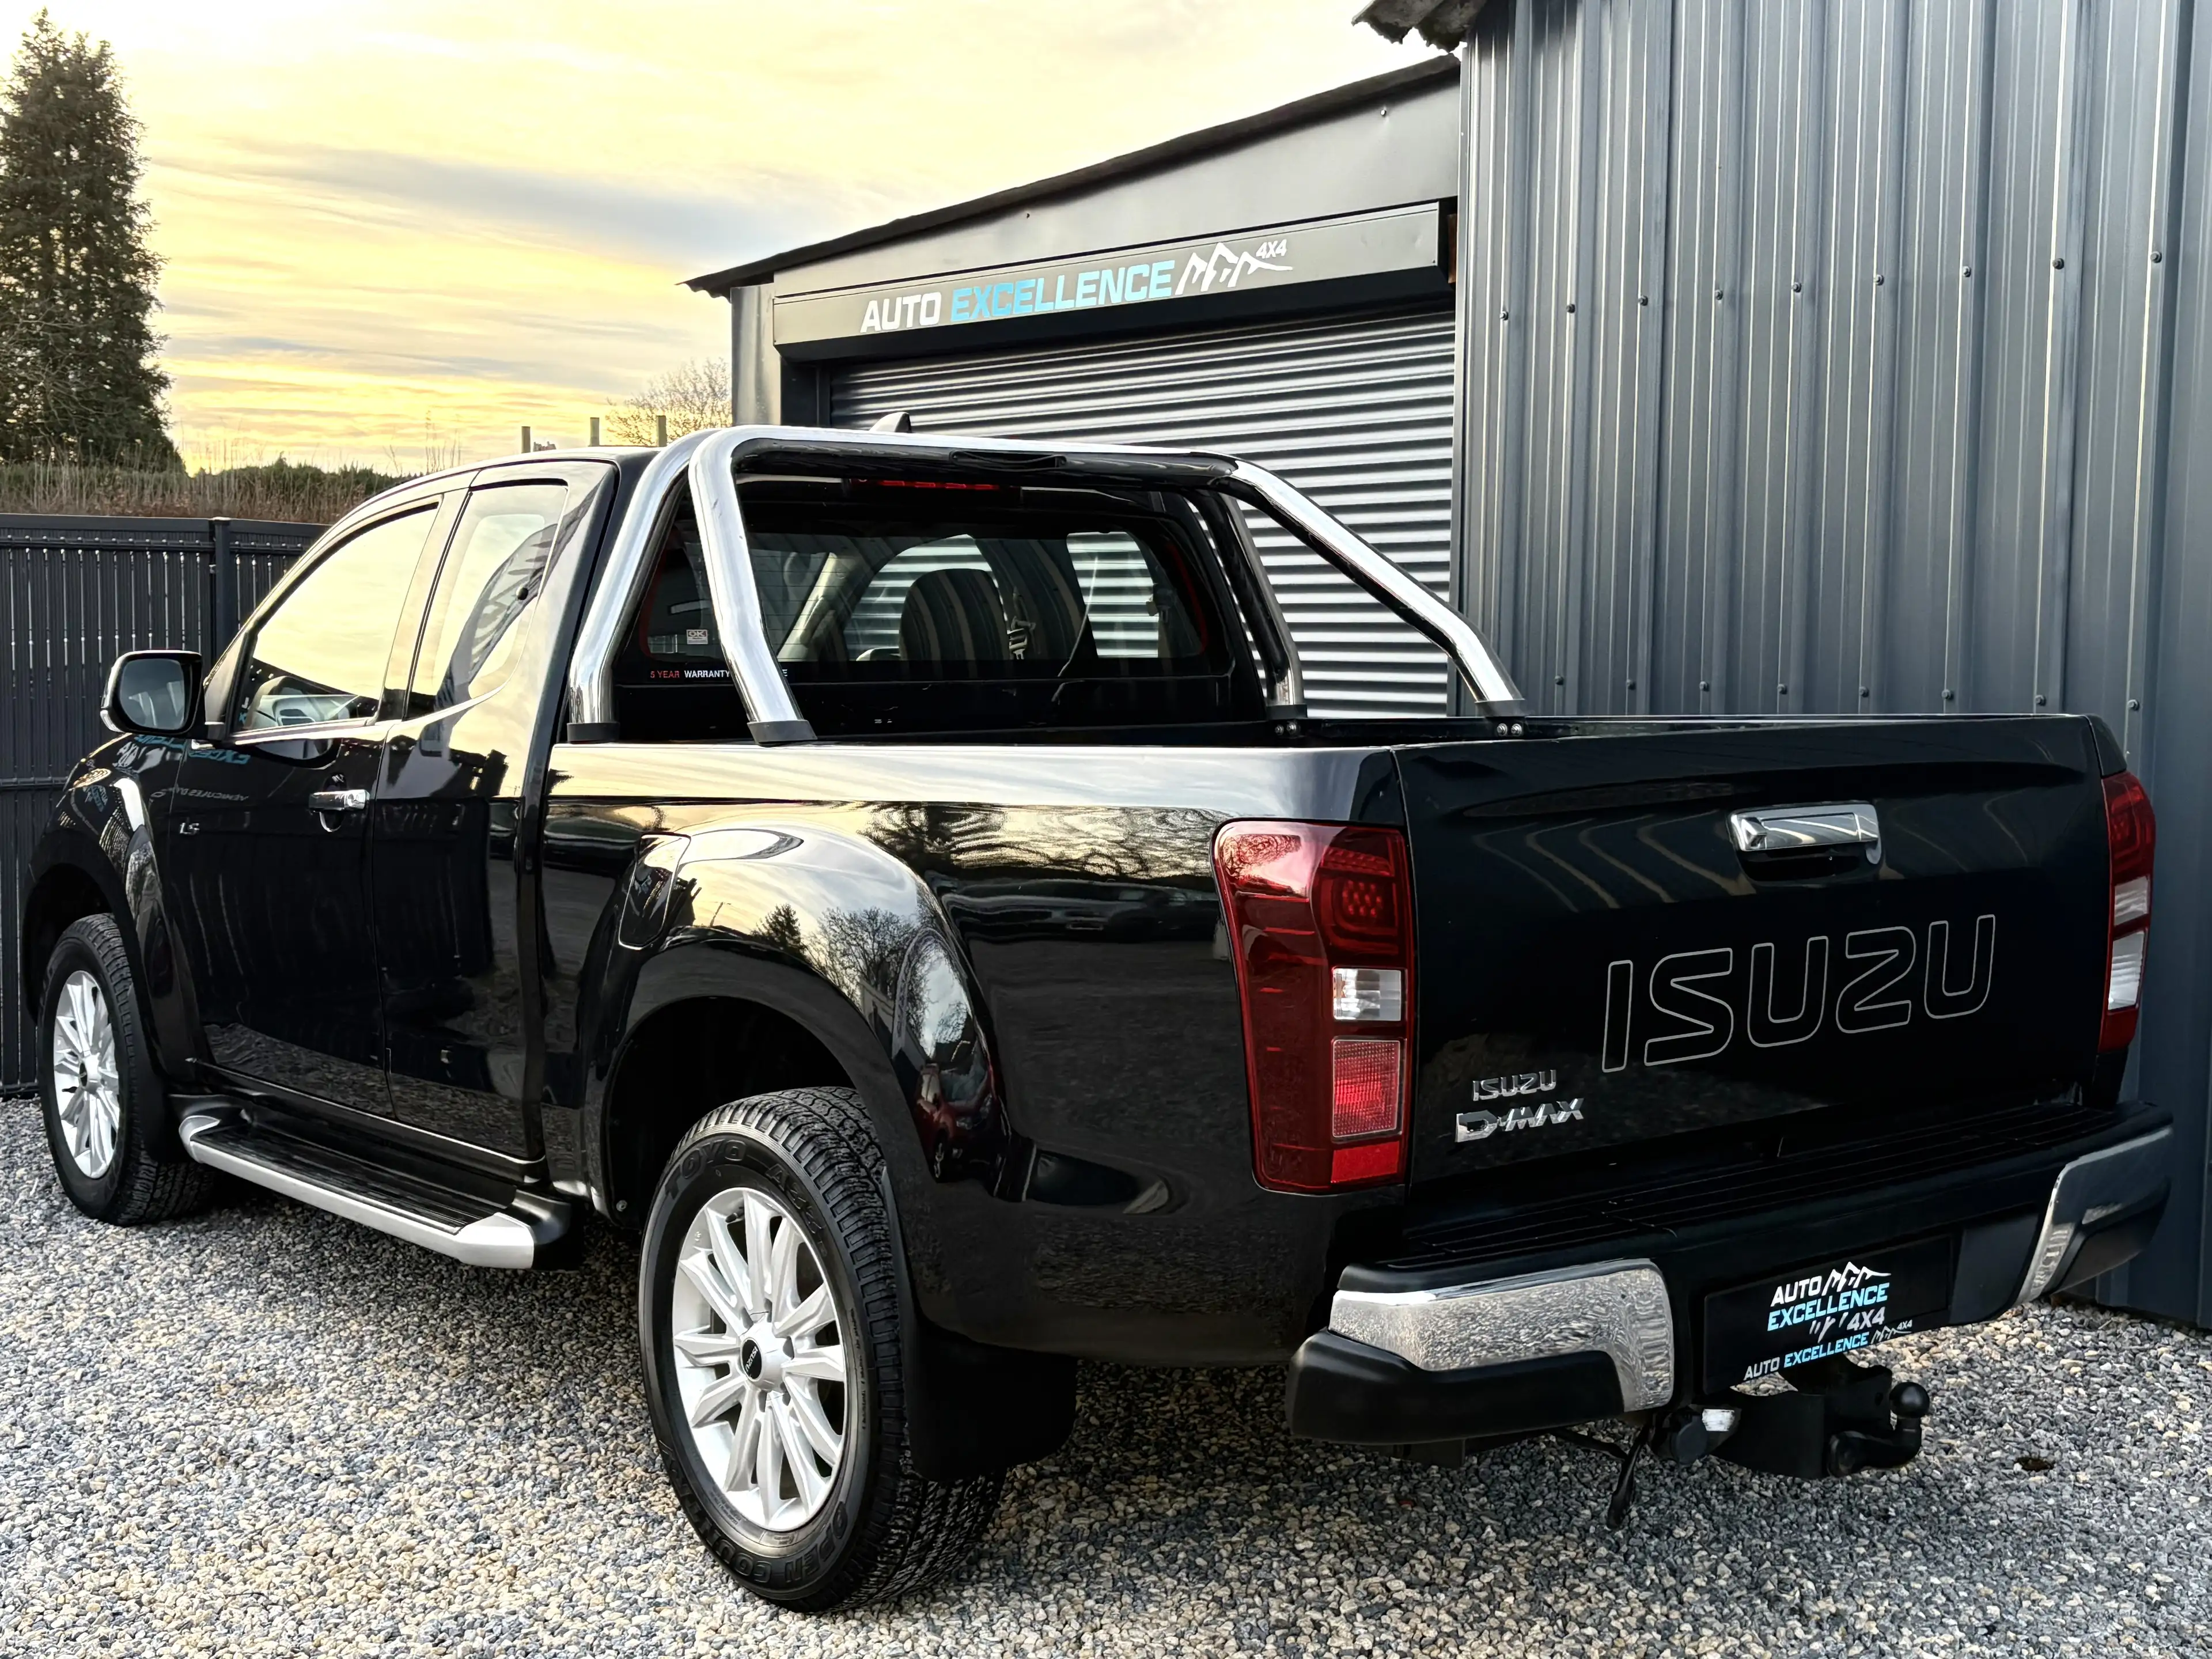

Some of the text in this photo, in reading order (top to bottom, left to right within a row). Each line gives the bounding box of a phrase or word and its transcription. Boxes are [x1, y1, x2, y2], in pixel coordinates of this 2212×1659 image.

[859, 238, 1287, 334] AUTO EXCELLENCE 4X4
[650, 669, 730, 679] 5 YEAR WARRANTY
[1602, 914, 1996, 1073] ISUZU
[1472, 1069, 1556, 1102] ISUZU
[664, 1138, 747, 1200] TOYO
[1767, 1282, 1890, 1331] EXCELLENCE
[1770, 1275, 1821, 1307] AUTO
[1846, 1306, 1886, 1331] 4X4
[1743, 1319, 1913, 1381] AUTO EXCELLENCE 4X4
